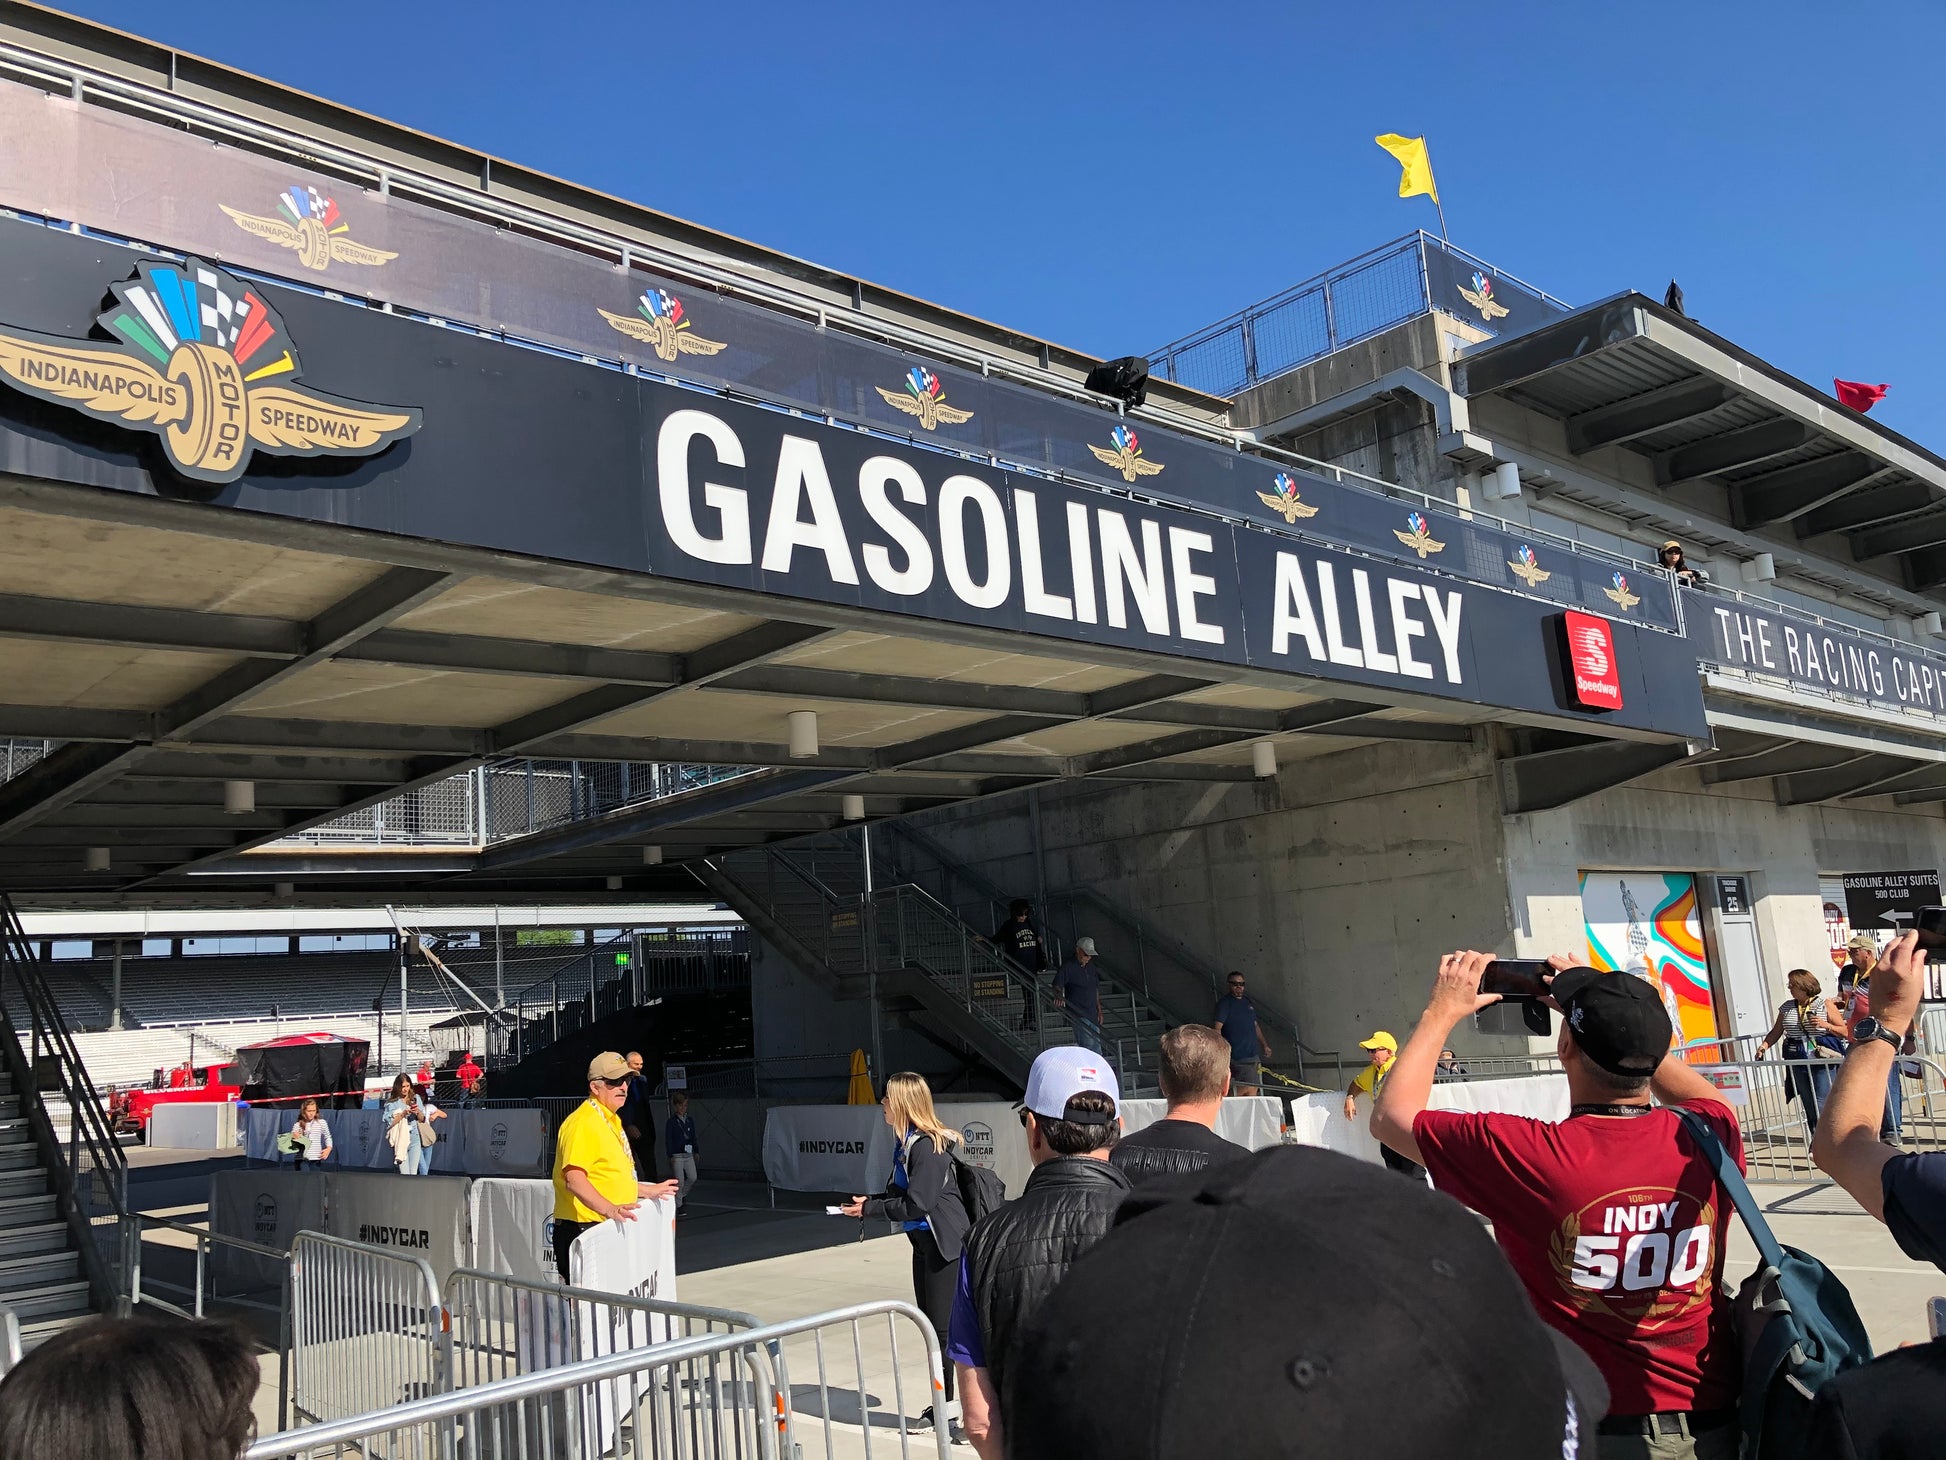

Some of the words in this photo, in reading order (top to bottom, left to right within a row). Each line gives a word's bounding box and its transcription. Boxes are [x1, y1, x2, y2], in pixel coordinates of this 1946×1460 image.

[241, 218, 302, 243] INDIANAPOLIS
[315, 225, 329, 266] MOTOR
[335, 245, 378, 263] SPEEDWAY
[613, 320, 657, 338] INDIANAPOLIS
[666, 322, 676, 358] MOTOR
[680, 338, 713, 353] SPEEDWAY
[19, 357, 177, 406] INDIANAPOLIS
[212, 361, 241, 460] MOTOR
[260, 406, 361, 442] SPEEDWAY
[657, 409, 1226, 646] GASOLINE
[1272, 551, 1463, 684] ALLEY
[1714, 607, 1775, 669] THE
[1784, 625, 1884, 696] RACING
[1892, 656, 1946, 709] CAPI
[1577, 675, 1618, 698] Speedway
[1844, 876, 1883, 889] GASOLINE
[1884, 875, 1908, 887] ALLEY
[1909, 874, 1939, 886] SUITES
[1875, 889, 1888, 899] 500
[1889, 888, 1910, 898] CLUB
[1727, 896, 1739, 912] 25
[981, 979, 1004, 988] STOPPING
[981, 987, 1005, 996] STANDING
[143, 1085, 206, 1095] SILVERADO
[975, 1132, 990, 1141] NTT
[799, 1140, 864, 1154] #INDYCAR
[963, 1146, 994, 1155] INDYCAR
[1604, 1201, 1679, 1233] INDY
[359, 1224, 429, 1249] #INDYCAR
[1570, 1224, 1711, 1291] 500
